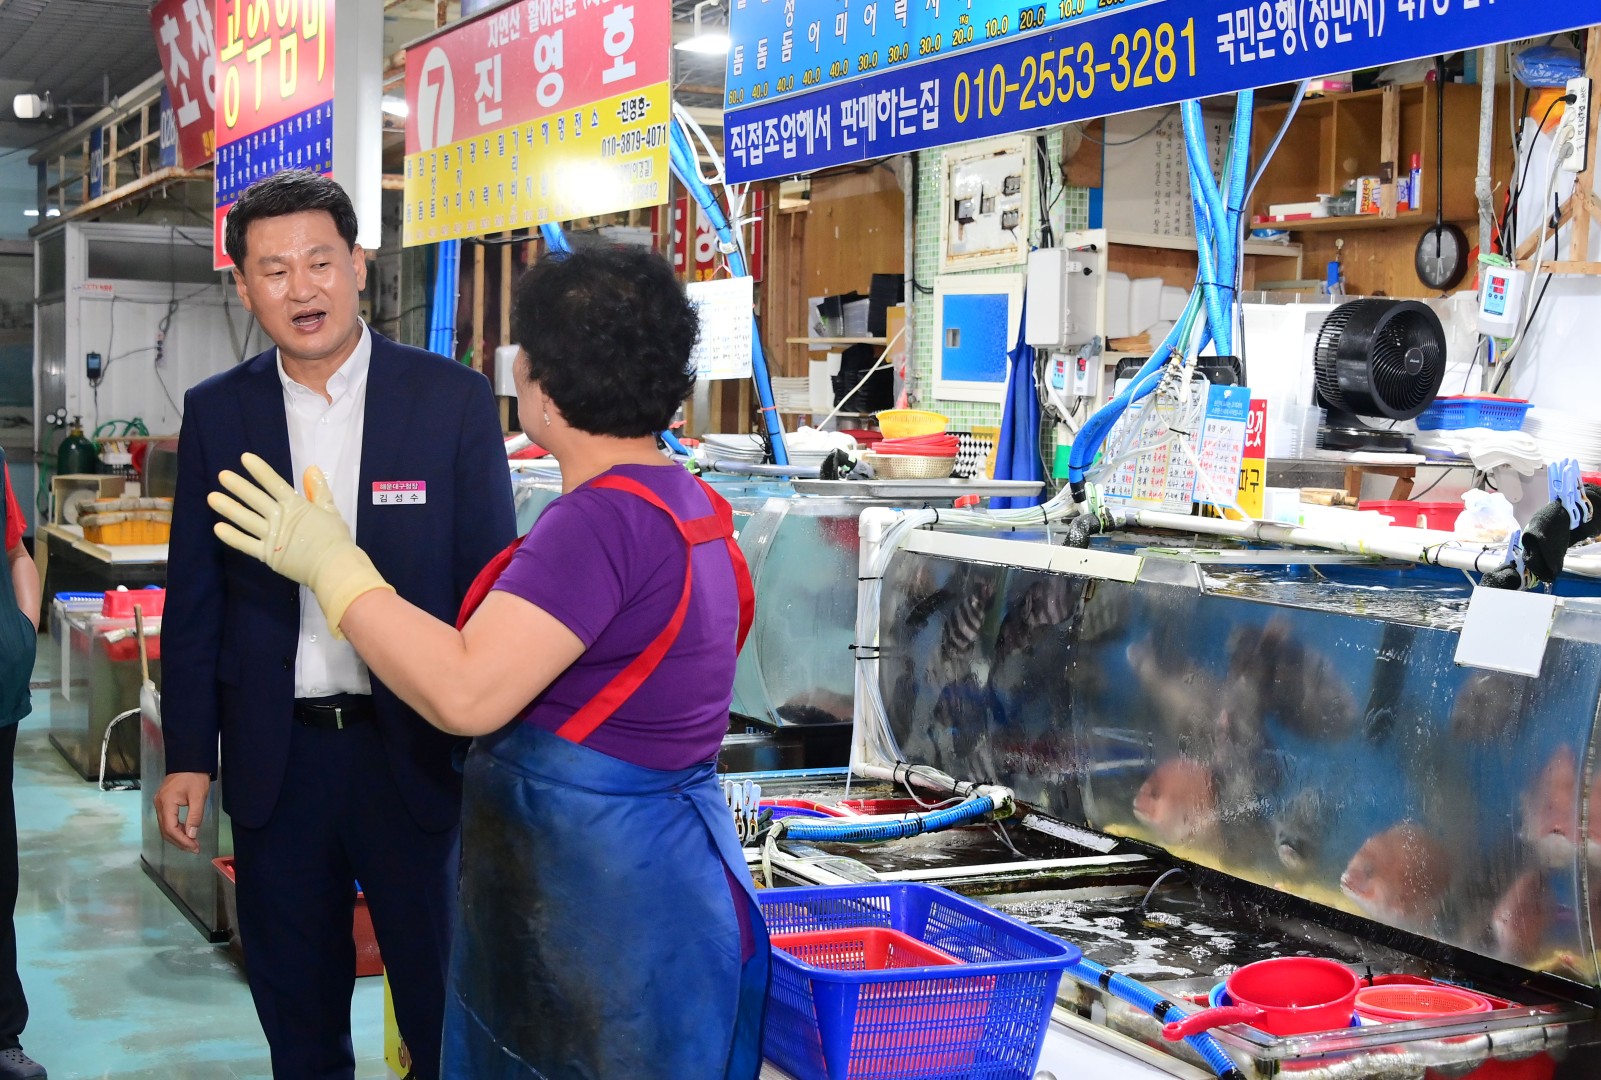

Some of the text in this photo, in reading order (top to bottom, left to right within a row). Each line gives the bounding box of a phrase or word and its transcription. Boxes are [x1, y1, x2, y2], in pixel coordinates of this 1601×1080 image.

[487, 12, 520, 48] 자연산
[728, 88, 744, 105] 60.0
[751, 82, 769, 99] 40.0
[776, 75, 794, 93] 40.0
[802, 67, 821, 86] 40.0
[829, 59, 849, 78] 40.0
[858, 51, 878, 71] 30.0
[888, 43, 909, 63] 30.0
[919, 34, 942, 55] 30.0
[952, 26, 974, 46] 20.0
[985, 16, 1008, 38] 10.0
[1019, 6, 1045, 29] 20.0
[730, 104, 831, 168] 직접조업해서
[840, 79, 940, 147] 판매하는집
[954, 17, 1196, 123] 010-2553-3281
[602, 124, 667, 158] 010-3879-4071
[379, 493, 419, 503] 김성수
